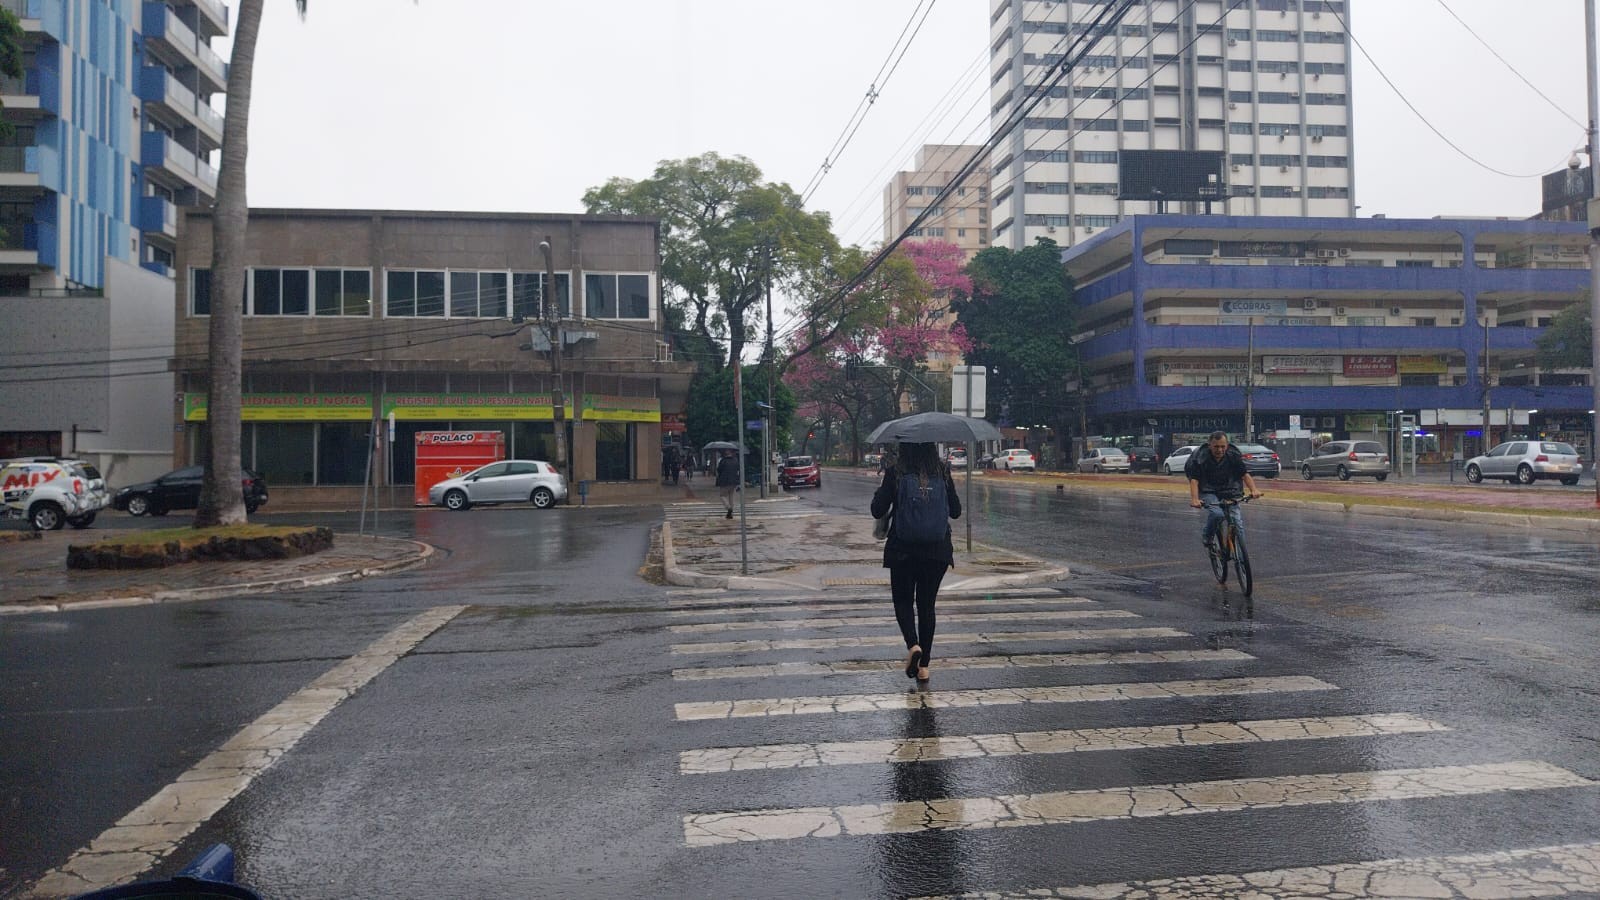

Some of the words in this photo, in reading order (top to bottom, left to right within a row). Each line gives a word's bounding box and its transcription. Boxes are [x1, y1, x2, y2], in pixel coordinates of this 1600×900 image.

[1232, 302, 1271, 310] ECOBRAS
[304, 397, 319, 406] DE
[324, 396, 367, 406] NOTAS
[527, 397, 570, 405] NATUS
[432, 434, 475, 443] POLACO
